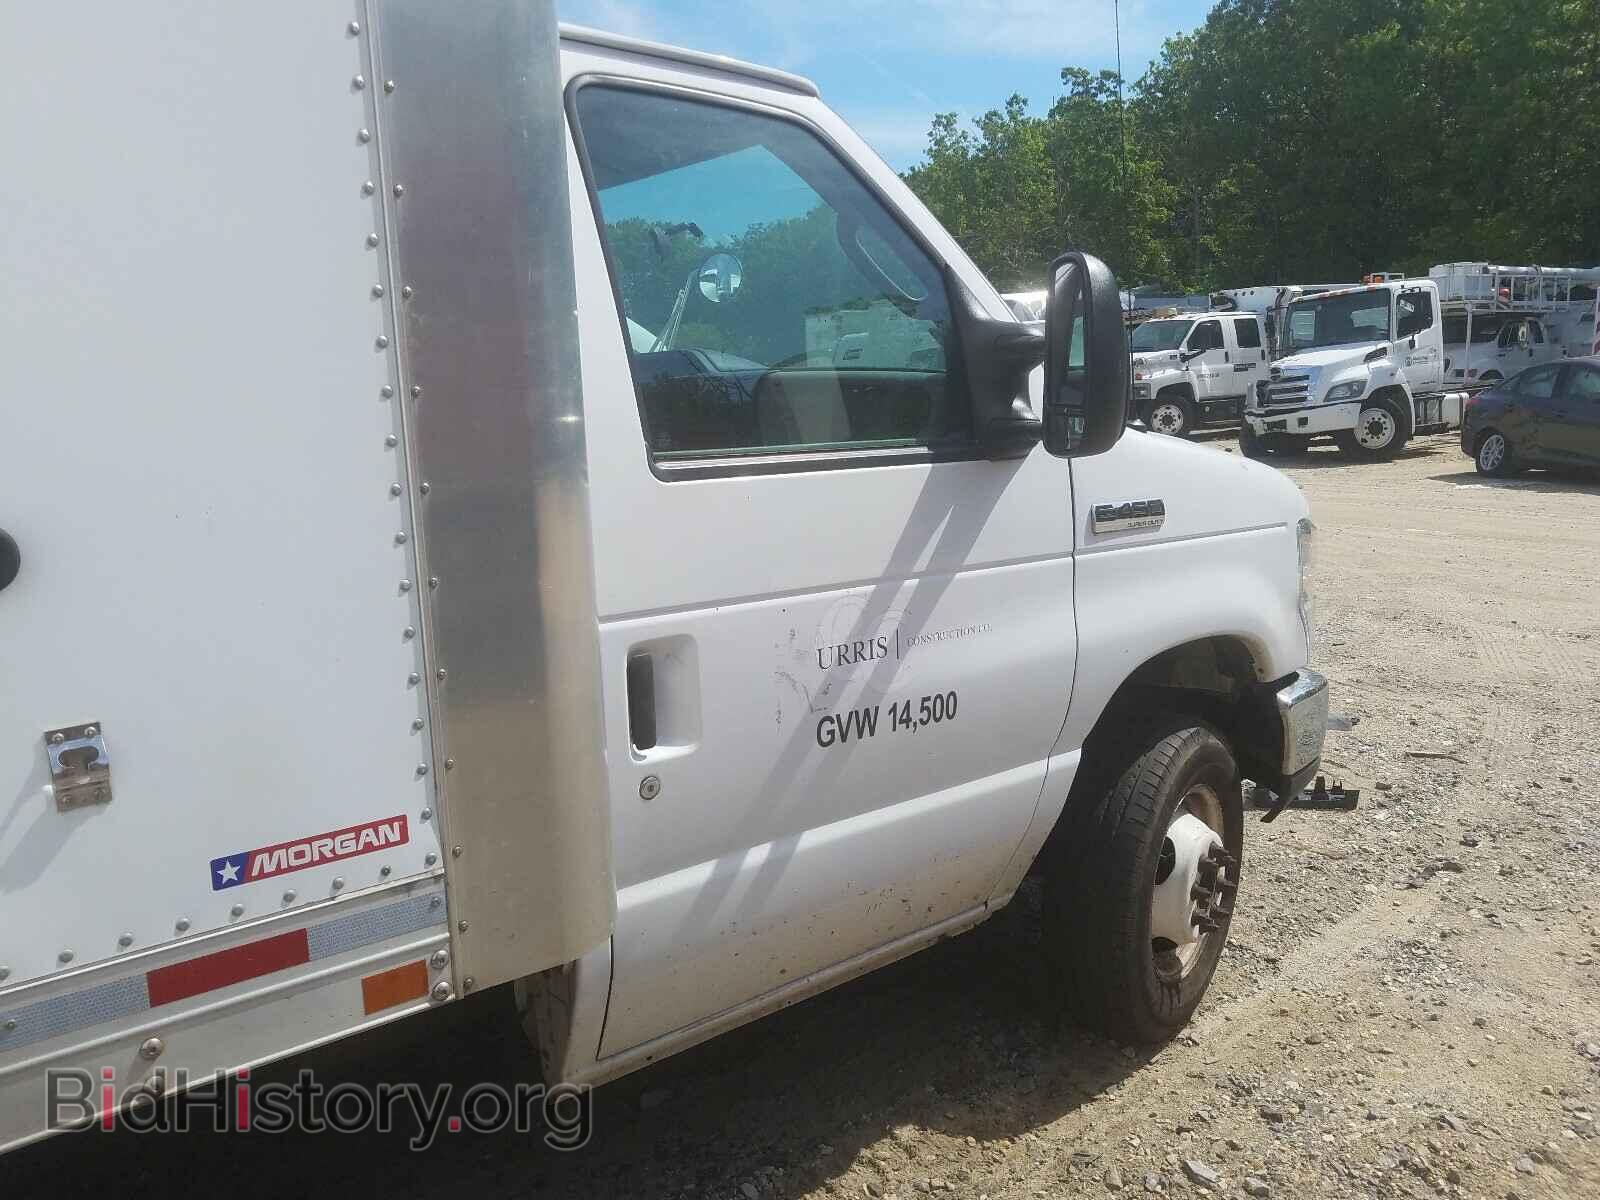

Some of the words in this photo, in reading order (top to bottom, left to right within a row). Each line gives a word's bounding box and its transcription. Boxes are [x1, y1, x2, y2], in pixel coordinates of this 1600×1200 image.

[816, 636, 888, 670] URRIS
[907, 626, 976, 647] CONSTRUCTION
[816, 706, 880, 748] GVW
[888, 691, 958, 734] 14,500
[251, 821, 401, 876] MORGAN
